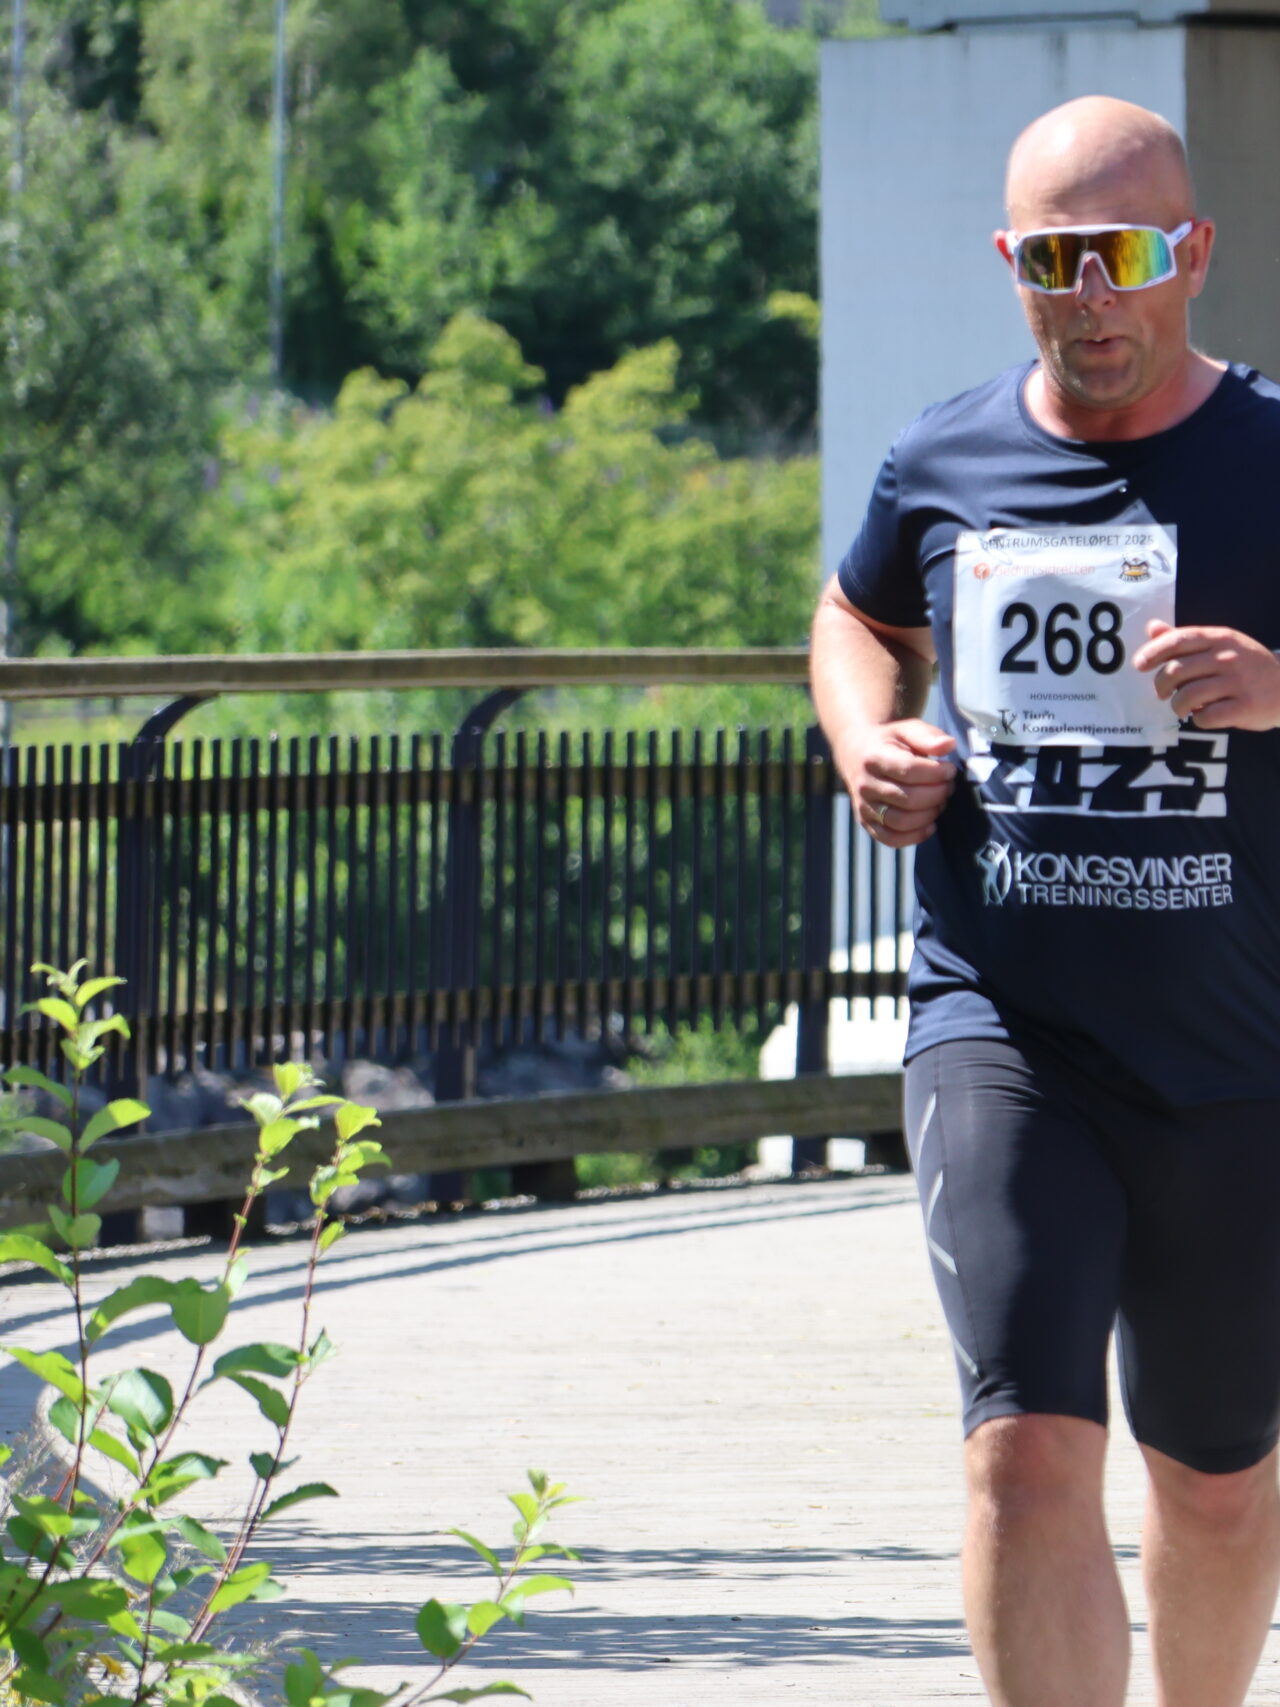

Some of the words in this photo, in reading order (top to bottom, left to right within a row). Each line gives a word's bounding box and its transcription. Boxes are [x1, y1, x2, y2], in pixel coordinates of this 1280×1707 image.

[1000, 600, 1125, 676] 268
[1022, 722, 1144, 736] Konsulenttjenester
[1014, 853, 1232, 887] KONGSVINGER
[1017, 883, 1233, 910] TRENINGSSENTER
